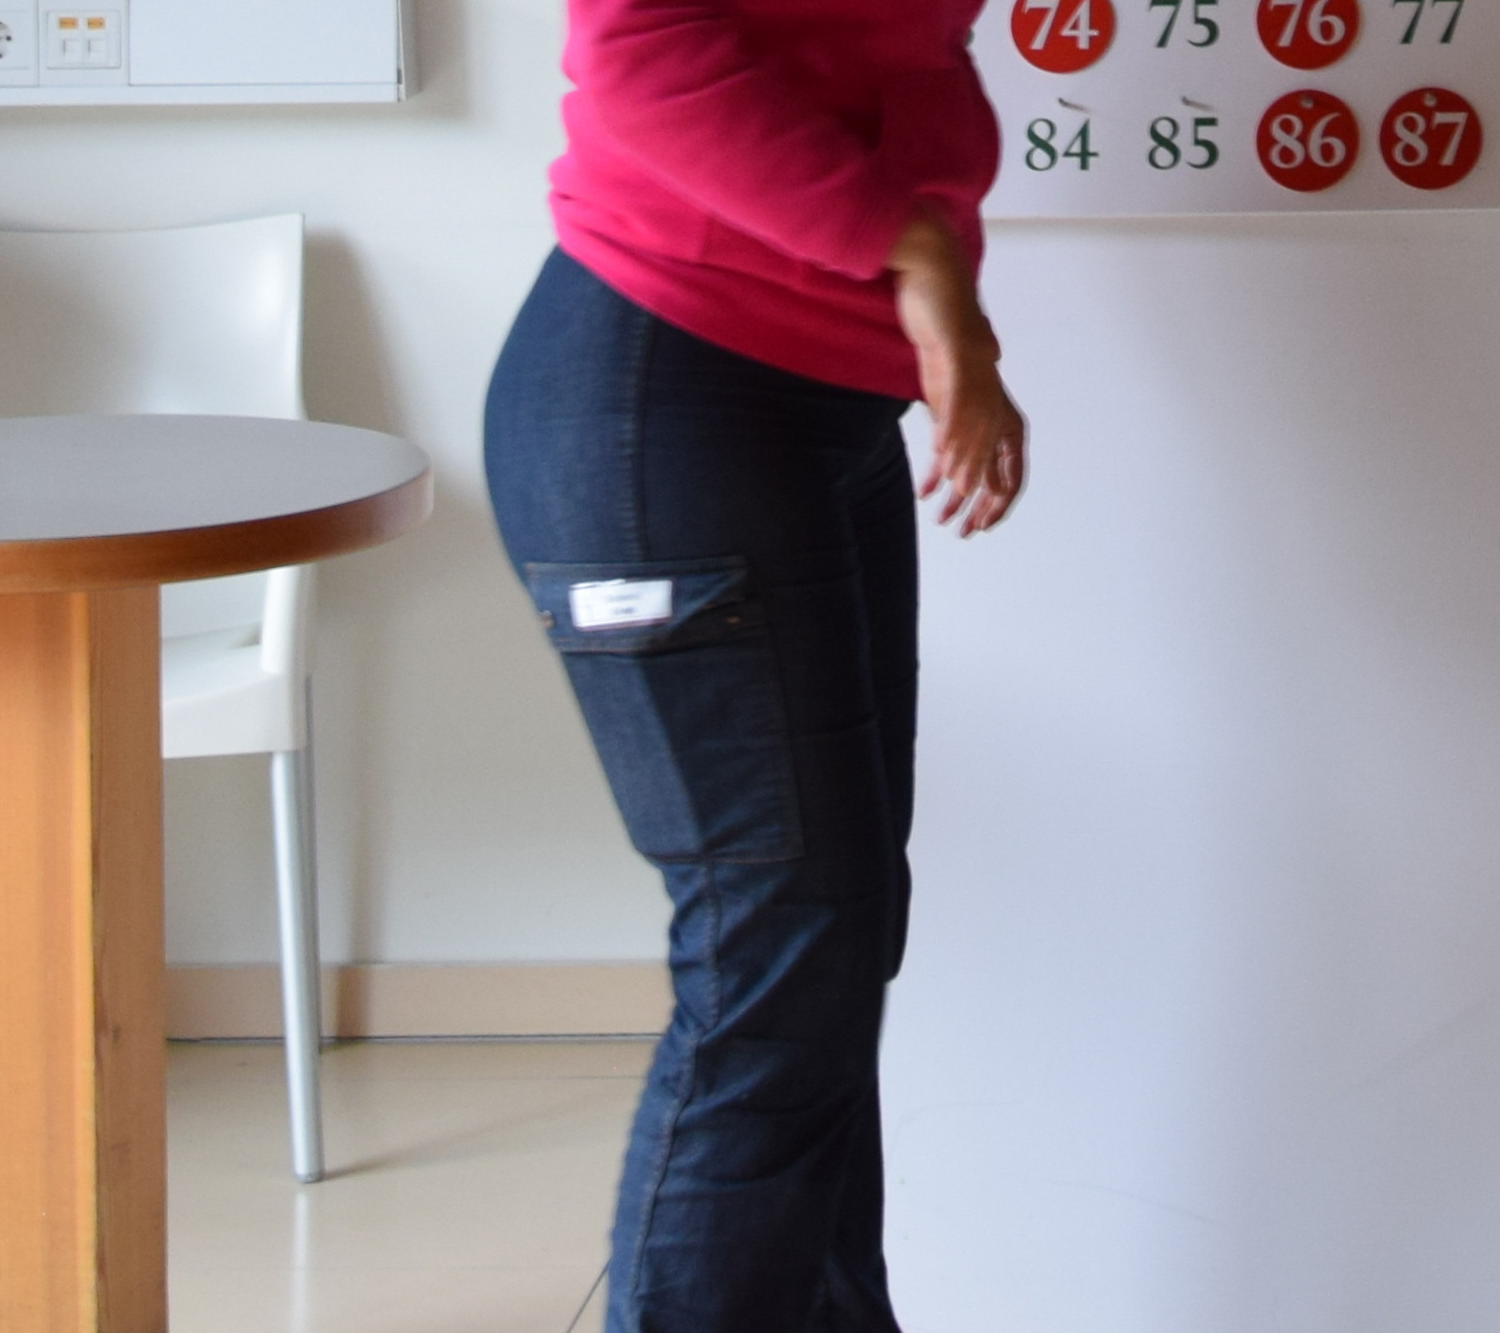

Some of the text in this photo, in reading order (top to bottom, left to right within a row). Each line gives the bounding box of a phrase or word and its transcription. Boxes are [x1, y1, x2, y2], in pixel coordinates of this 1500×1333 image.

[1025, 118, 1099, 171] 84
[1148, 116, 1220, 170] 85
[1269, 113, 1346, 169] 86
[1393, 111, 1467, 167] 87
